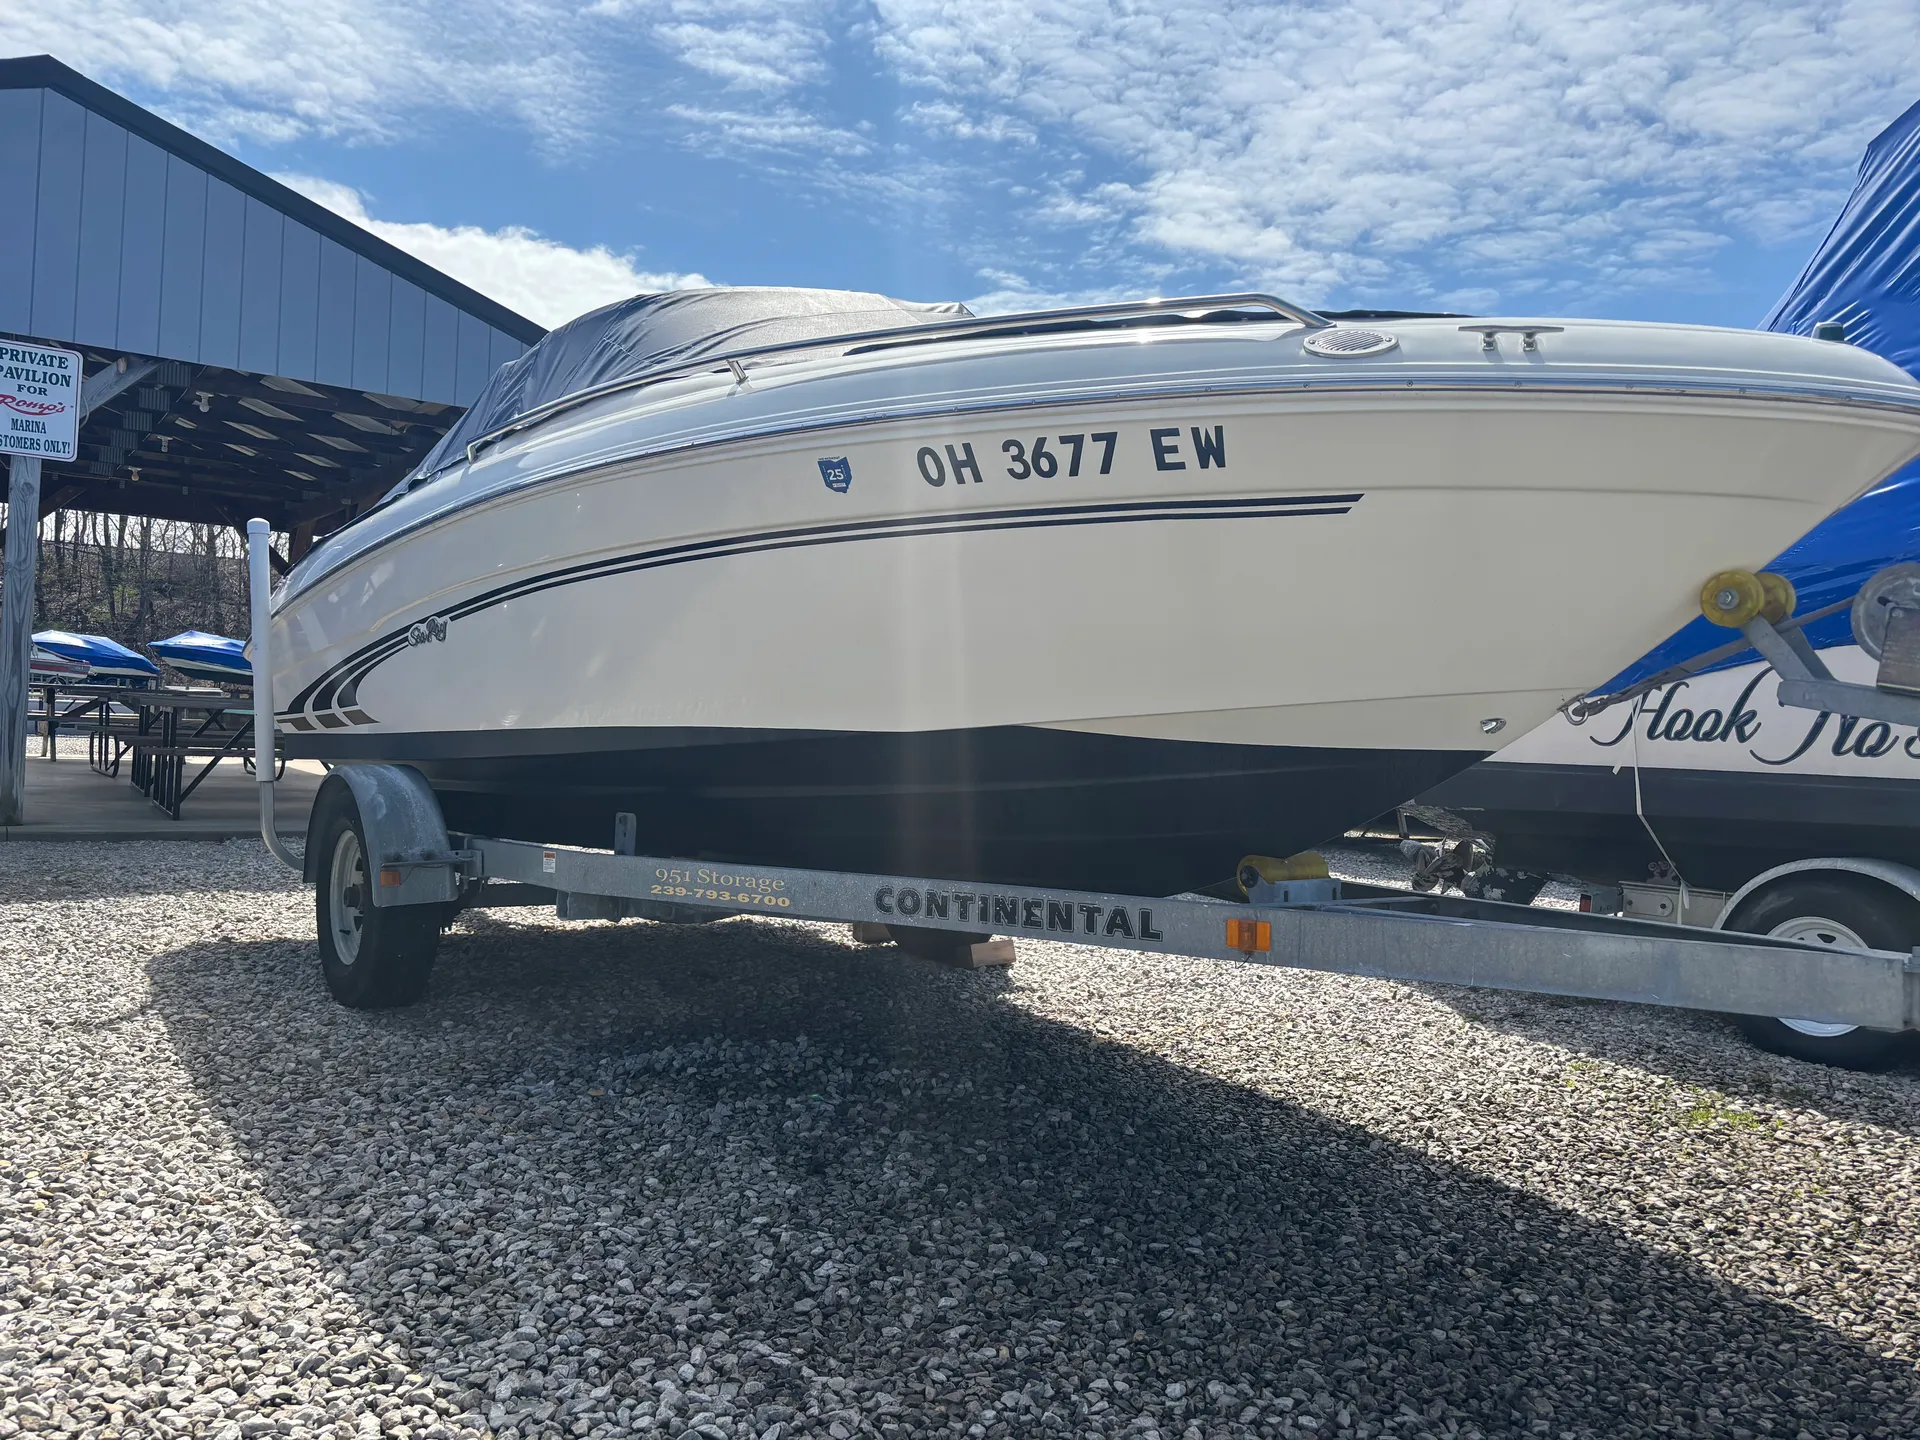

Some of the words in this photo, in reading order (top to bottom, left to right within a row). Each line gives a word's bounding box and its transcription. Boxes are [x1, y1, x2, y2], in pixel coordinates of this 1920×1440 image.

[0, 347, 69, 370] PRIVATE
[17, 384, 48, 396] FOR
[11, 418, 47, 434] MARINA
[43, 439, 71, 454] ONLY!
[916, 442, 984, 488] OH
[1001, 431, 1119, 481] 3677
[1149, 424, 1227, 472] EW
[827, 468, 844, 481] 25
[1590, 665, 1775, 747] Hook
[1749, 708, 1920, 766] No
[655, 868, 690, 884] 951
[697, 868, 786, 894] Storage
[650, 884, 791, 908] 239-793-6700
[874, 885, 1163, 943] CONTINENTAL
